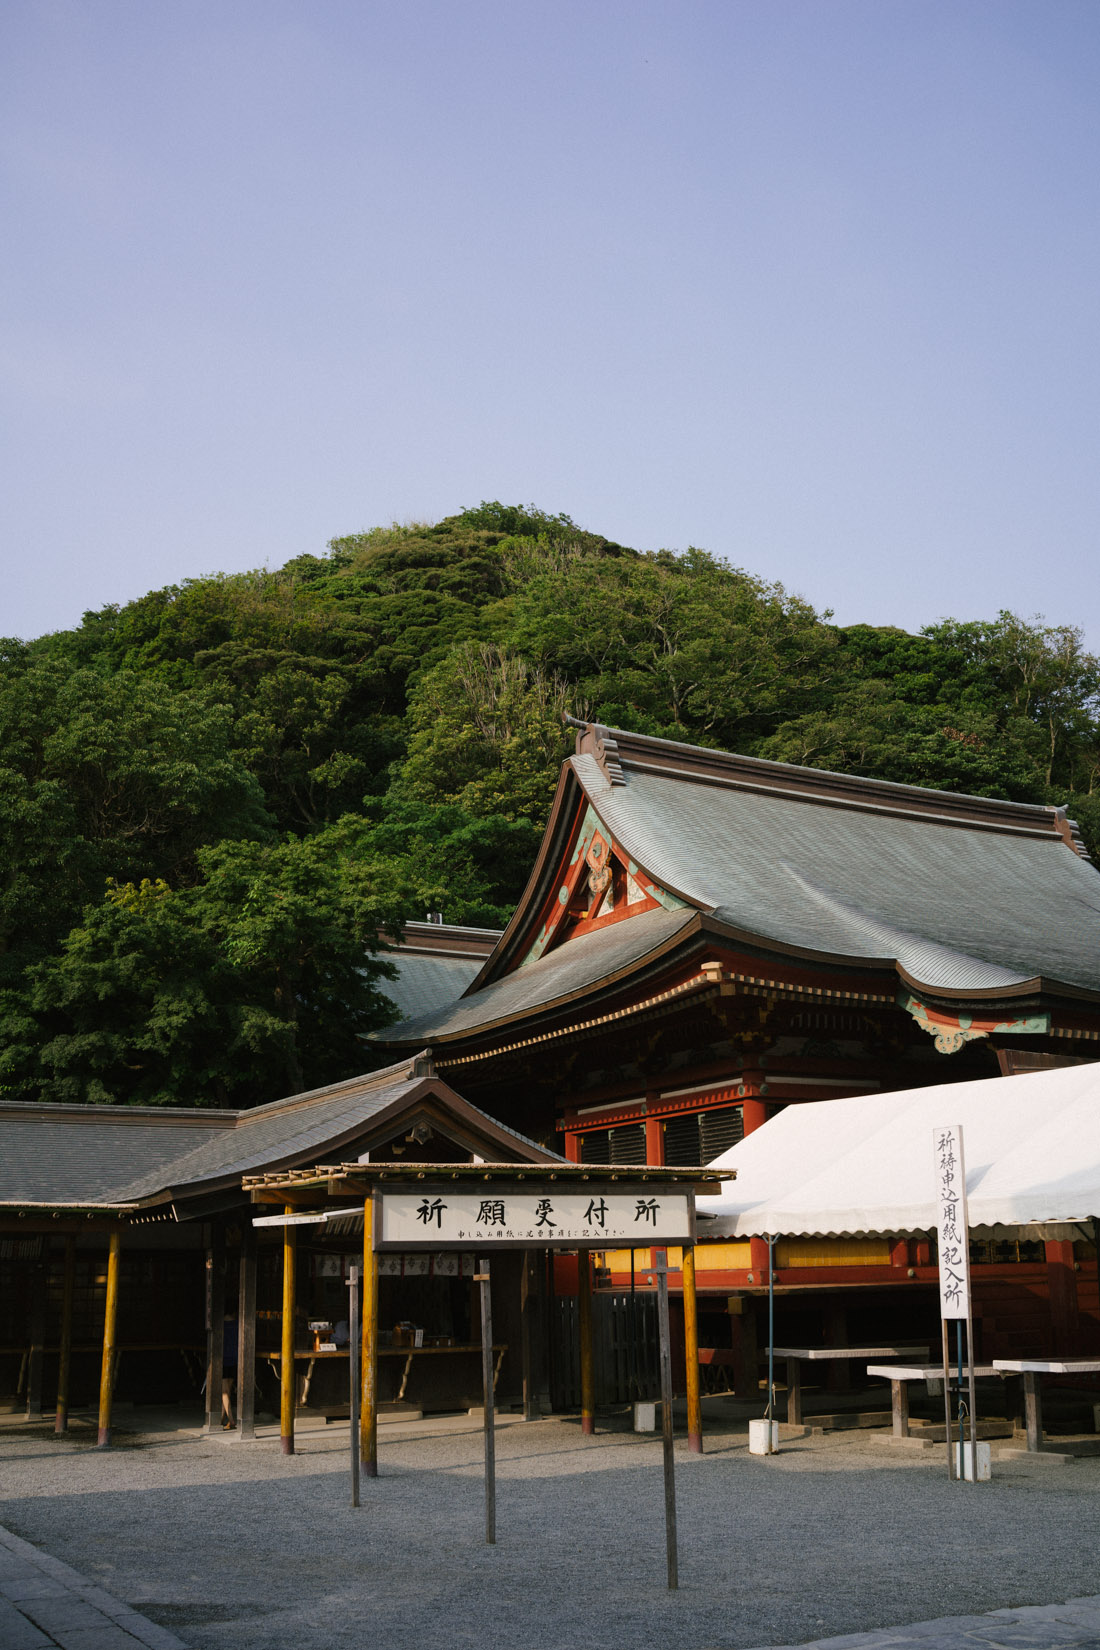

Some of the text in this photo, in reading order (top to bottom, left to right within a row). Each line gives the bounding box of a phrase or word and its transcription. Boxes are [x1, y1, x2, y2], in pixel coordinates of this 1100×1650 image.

[416, 1197, 661, 1229] 祈願受付所
[937, 1130, 965, 1310] 祈祷申込用紙記入所
